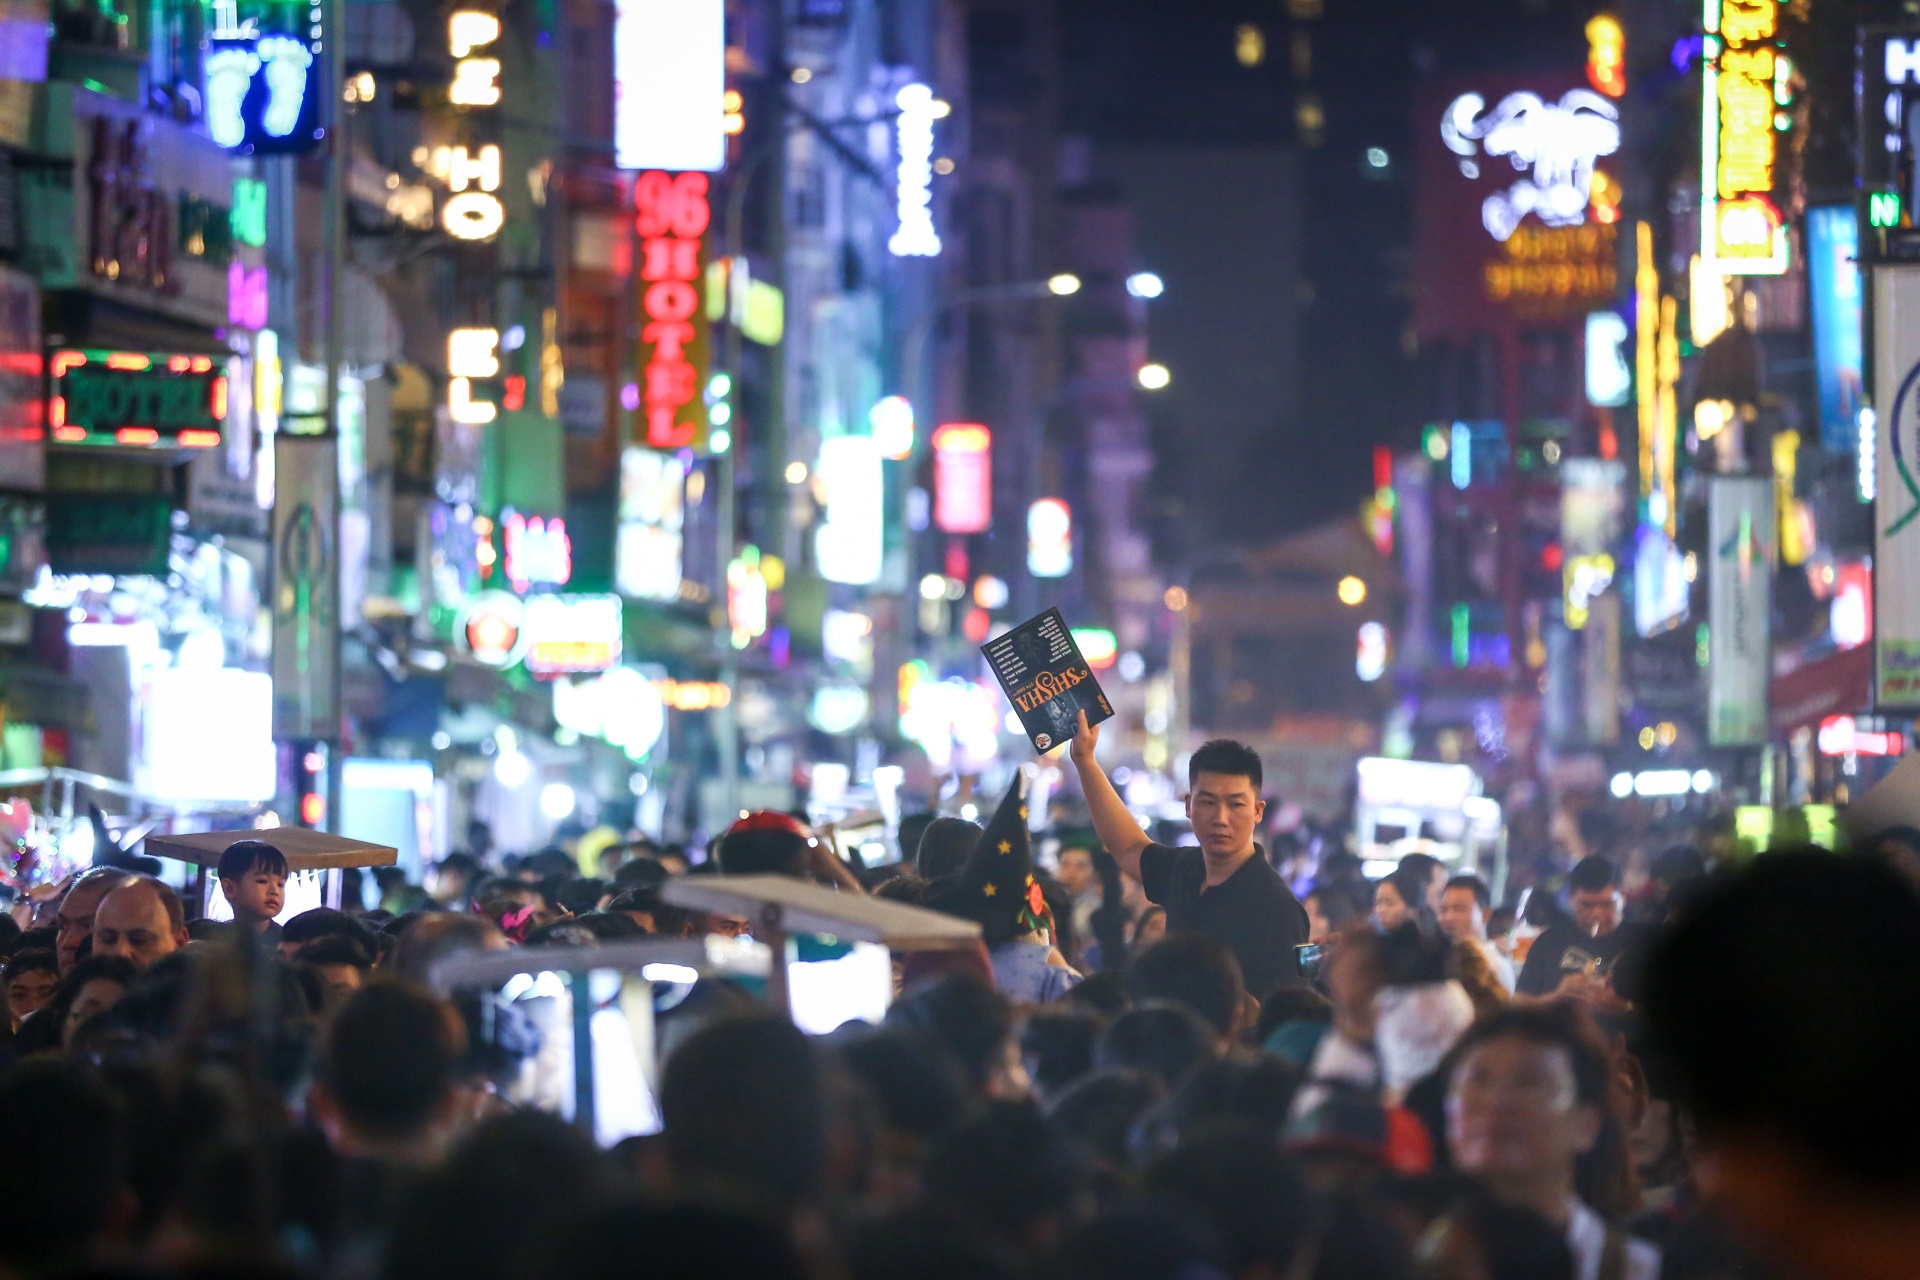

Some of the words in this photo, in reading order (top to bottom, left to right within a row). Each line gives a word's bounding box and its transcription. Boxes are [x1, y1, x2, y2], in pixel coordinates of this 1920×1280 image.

[634, 169, 711, 239] 96
[641, 238, 701, 447] HOTEL
[1015, 667, 1088, 713] SHISHA
